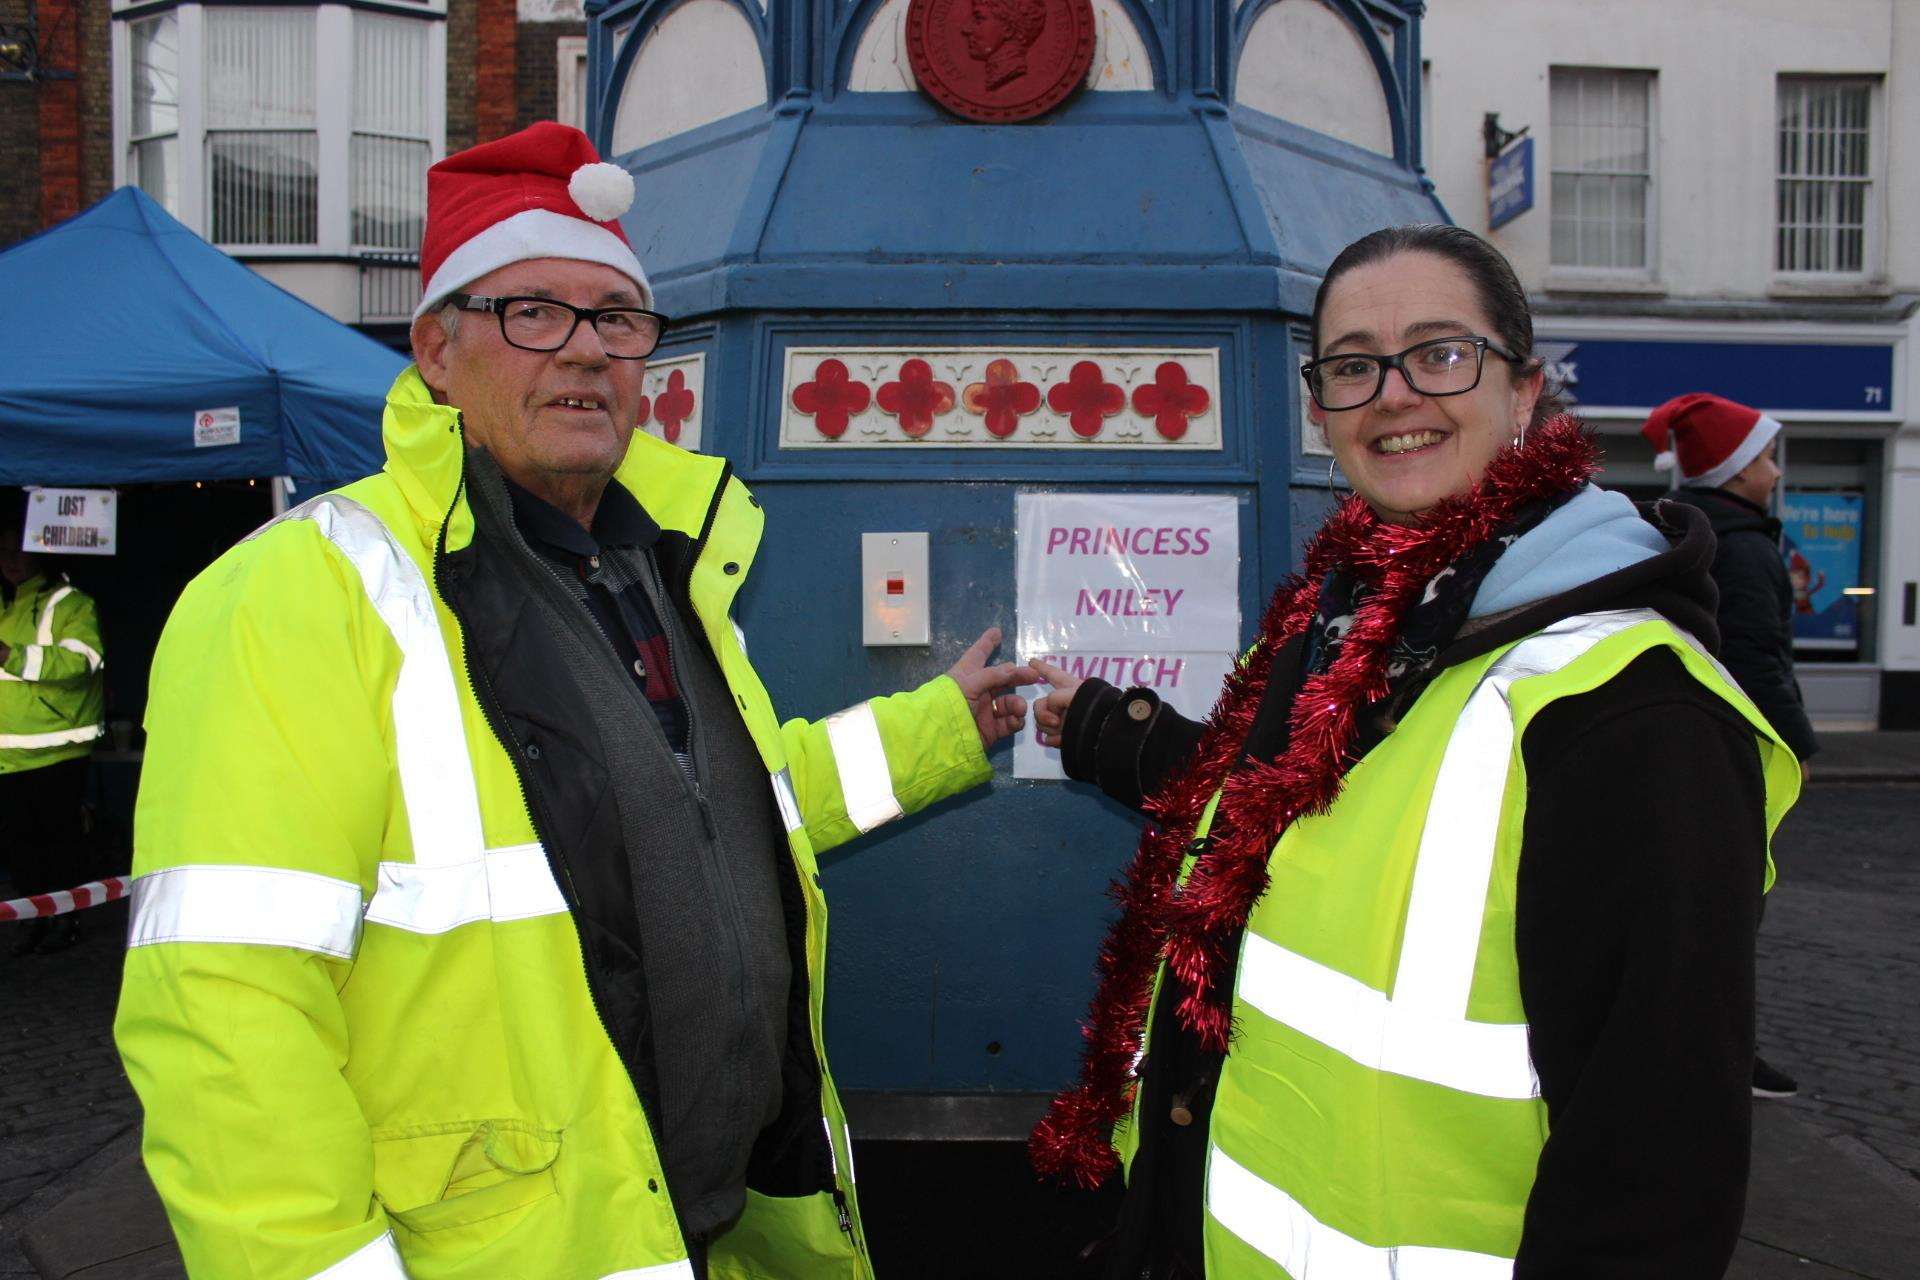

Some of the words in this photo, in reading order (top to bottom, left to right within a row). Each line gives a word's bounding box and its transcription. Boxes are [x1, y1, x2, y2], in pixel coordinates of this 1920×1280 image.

[1864, 386, 1882, 403] 71
[58, 496, 85, 516] LOST
[43, 525, 98, 548] CHILDREN
[1046, 527, 1211, 555] PRINCESS
[1075, 588, 1184, 616] MILEY
[1036, 655, 1184, 688] SWITCH
